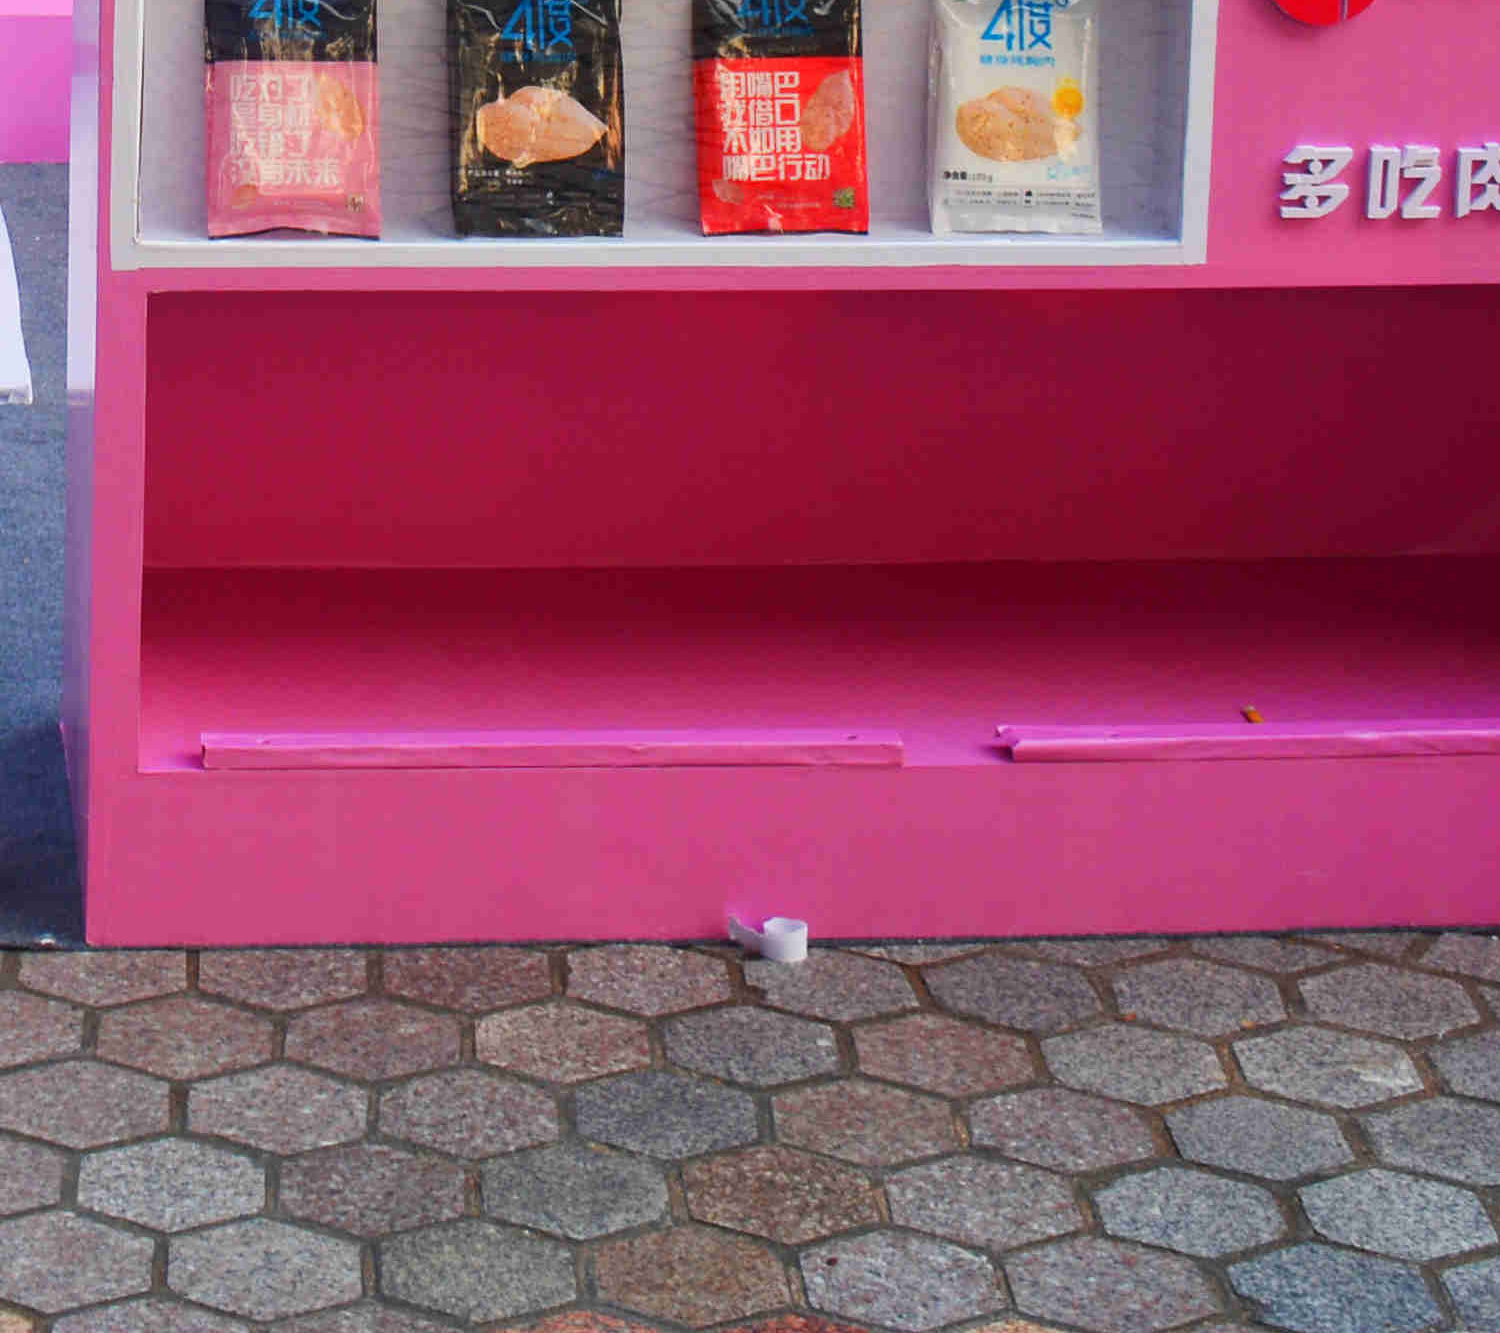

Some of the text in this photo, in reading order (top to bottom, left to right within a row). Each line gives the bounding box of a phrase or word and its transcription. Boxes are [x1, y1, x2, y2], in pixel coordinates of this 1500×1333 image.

[720, 72, 799, 99] 用嘴巴
[720, 99, 801, 126] 找借口
[722, 126, 801, 153] 不如用
[722, 154, 831, 181] 嘴巴行动
